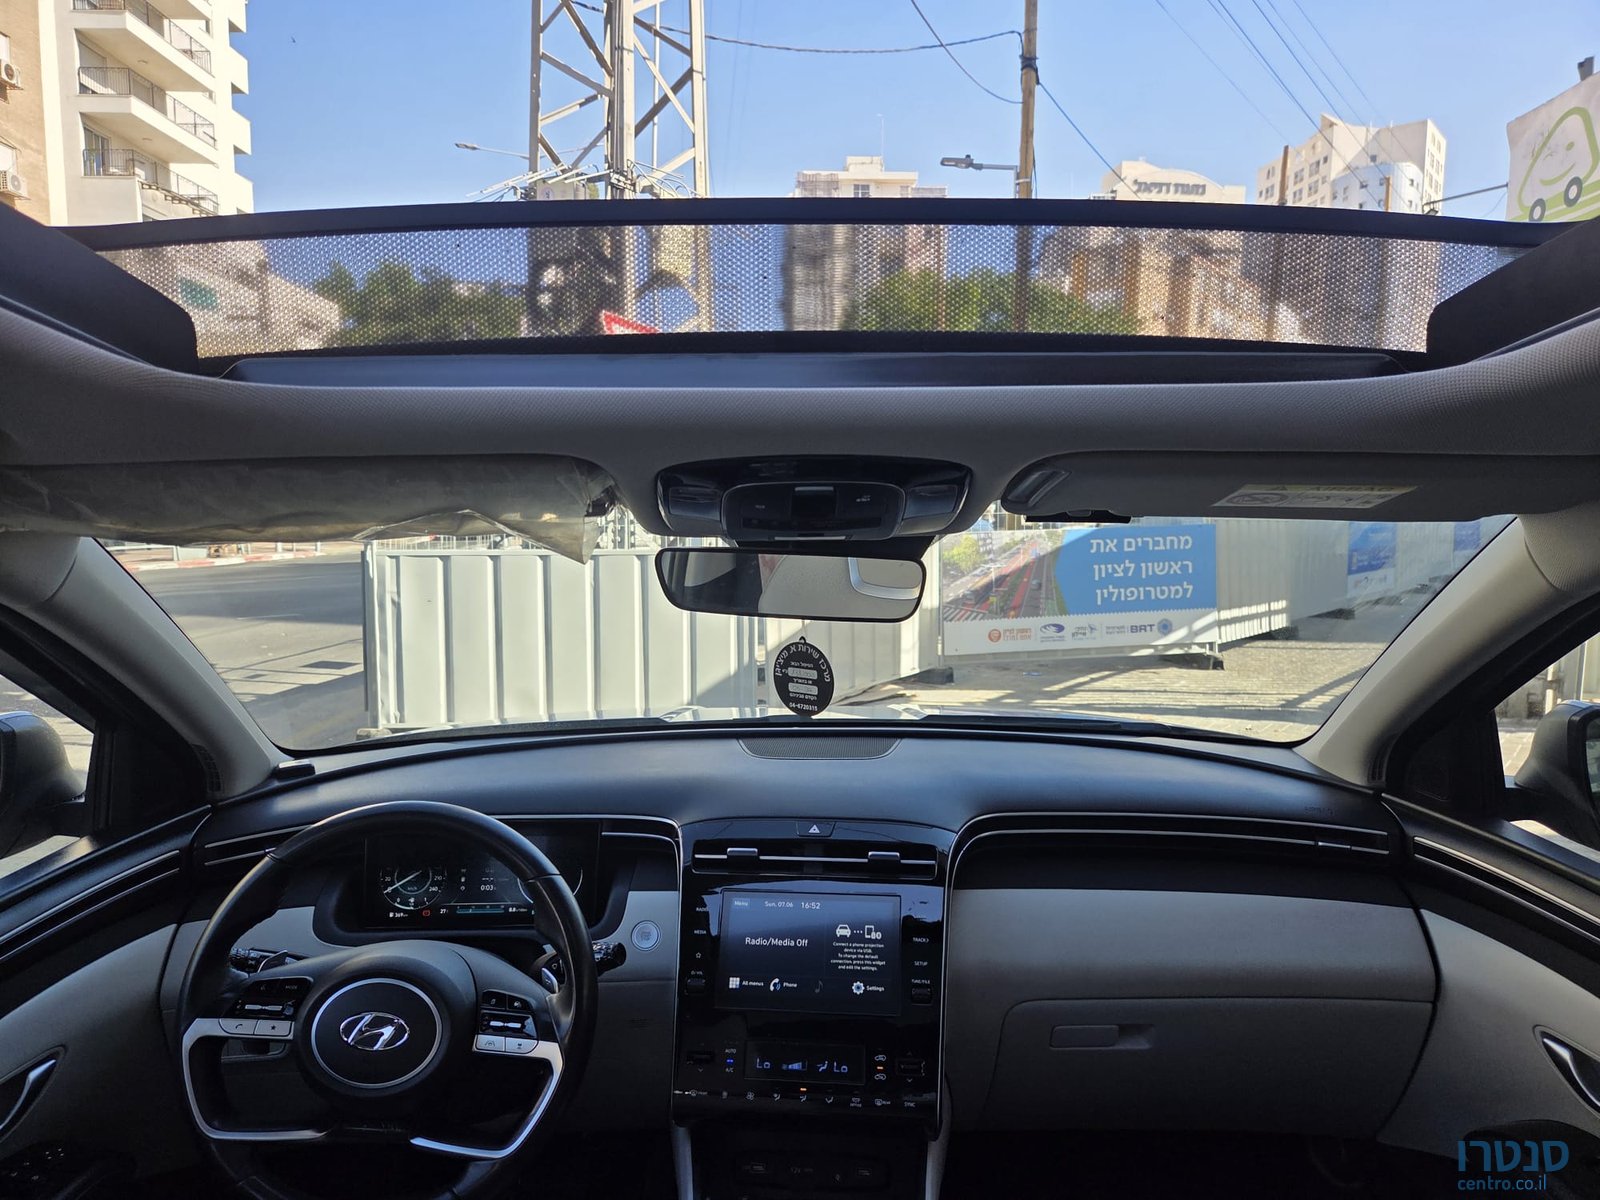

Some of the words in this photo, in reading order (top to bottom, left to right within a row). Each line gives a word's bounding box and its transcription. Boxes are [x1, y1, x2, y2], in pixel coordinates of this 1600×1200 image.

[1090, 538, 1118, 553] את
[1124, 535, 1193, 551] מחברים
[1094, 560, 1136, 580] לציון
[1141, 560, 1193, 577] ראשון
[1096, 582, 1194, 605] למטרופולין
[1129, 624, 1156, 633] BRT
[798, 644, 820, 659] שירות
[818, 659, 831, 682] מרכז
[745, 936, 795, 948] Radio/Media
[796, 938, 809, 947] Off
[756, 1057, 771, 1069] Lo
[833, 1060, 849, 1074] Lo
